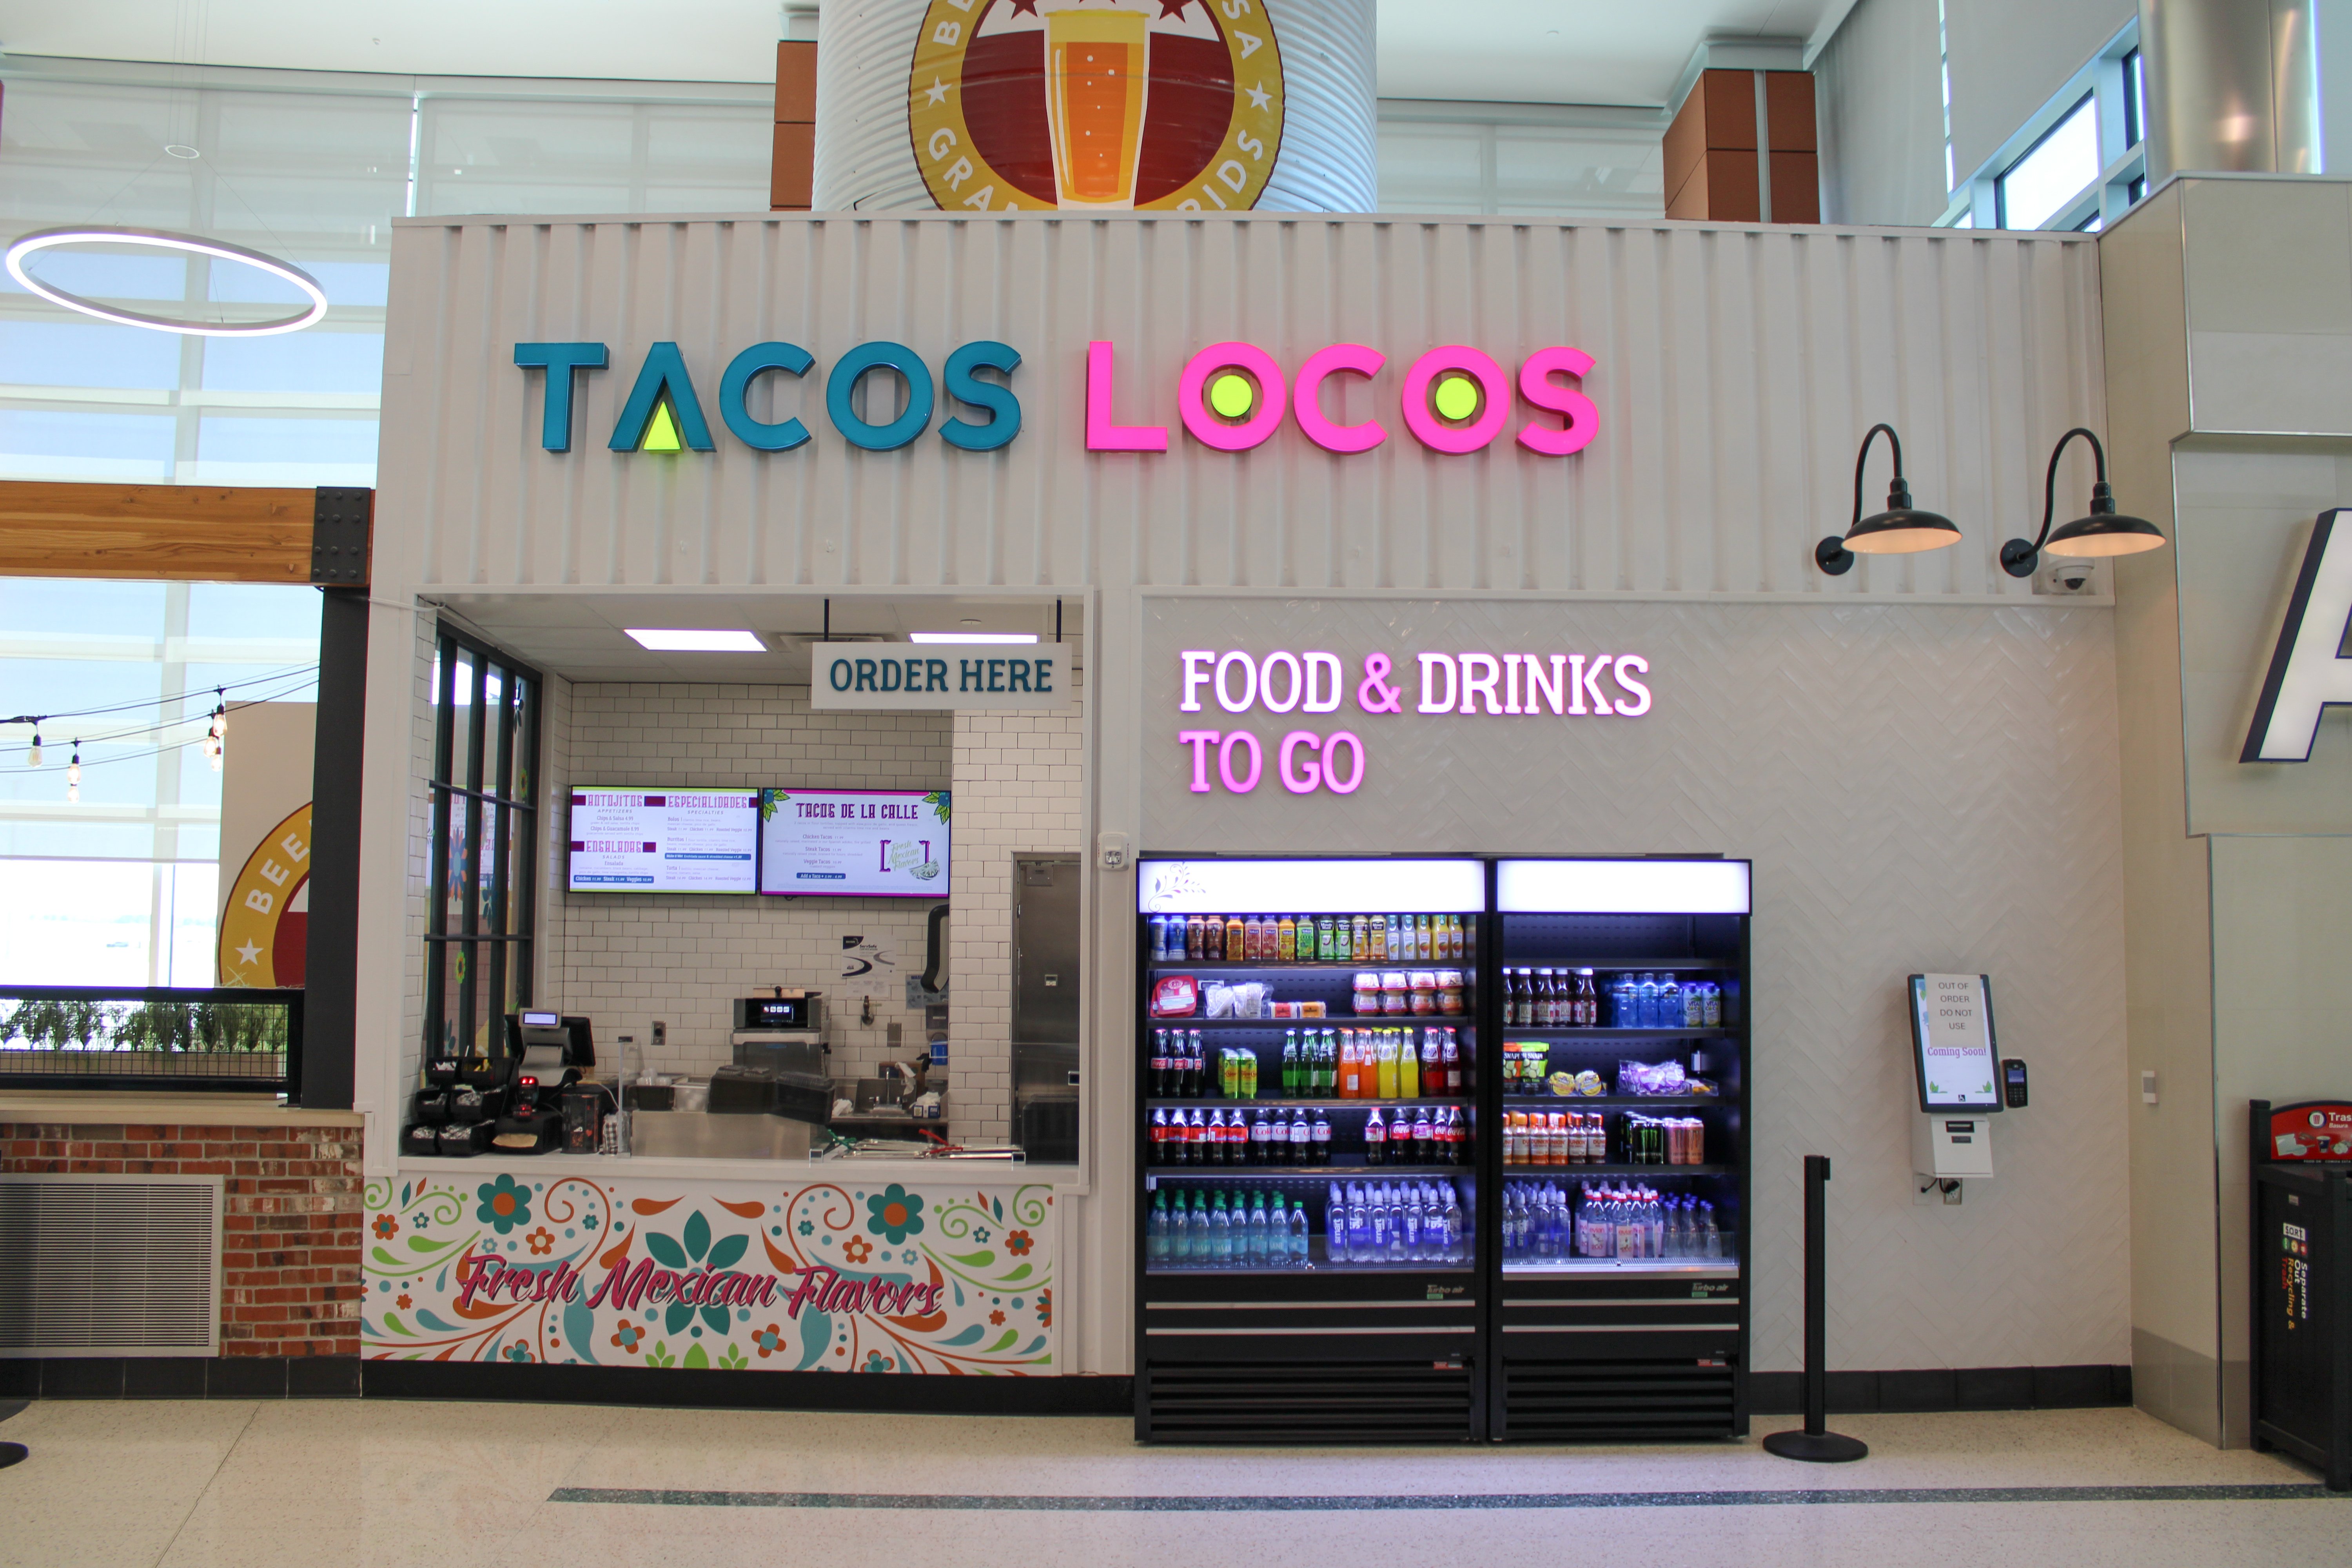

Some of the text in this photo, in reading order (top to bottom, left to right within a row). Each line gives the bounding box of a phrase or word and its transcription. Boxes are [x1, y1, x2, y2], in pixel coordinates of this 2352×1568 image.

[515, 340, 1600, 457] TACOS LOCOS
[830, 659, 1053, 692] ORDER HERE
[1180, 651, 1652, 717] FOOD & DRINKS
[1179, 731, 1365, 794] TO GO
[796, 803, 918, 820] TACOS DE LA CALLE
[586, 840, 642, 853] ENSALADAS
[888, 848, 919, 864] Mexican
[891, 840, 913, 853] Fresh
[245, 818, 312, 915] BEE
[893, 858, 918, 871] Flavors
[1927, 1047, 1986, 1058] Coming Soon!
[456, 1254, 944, 1320] Fresh Mexican Flavors
